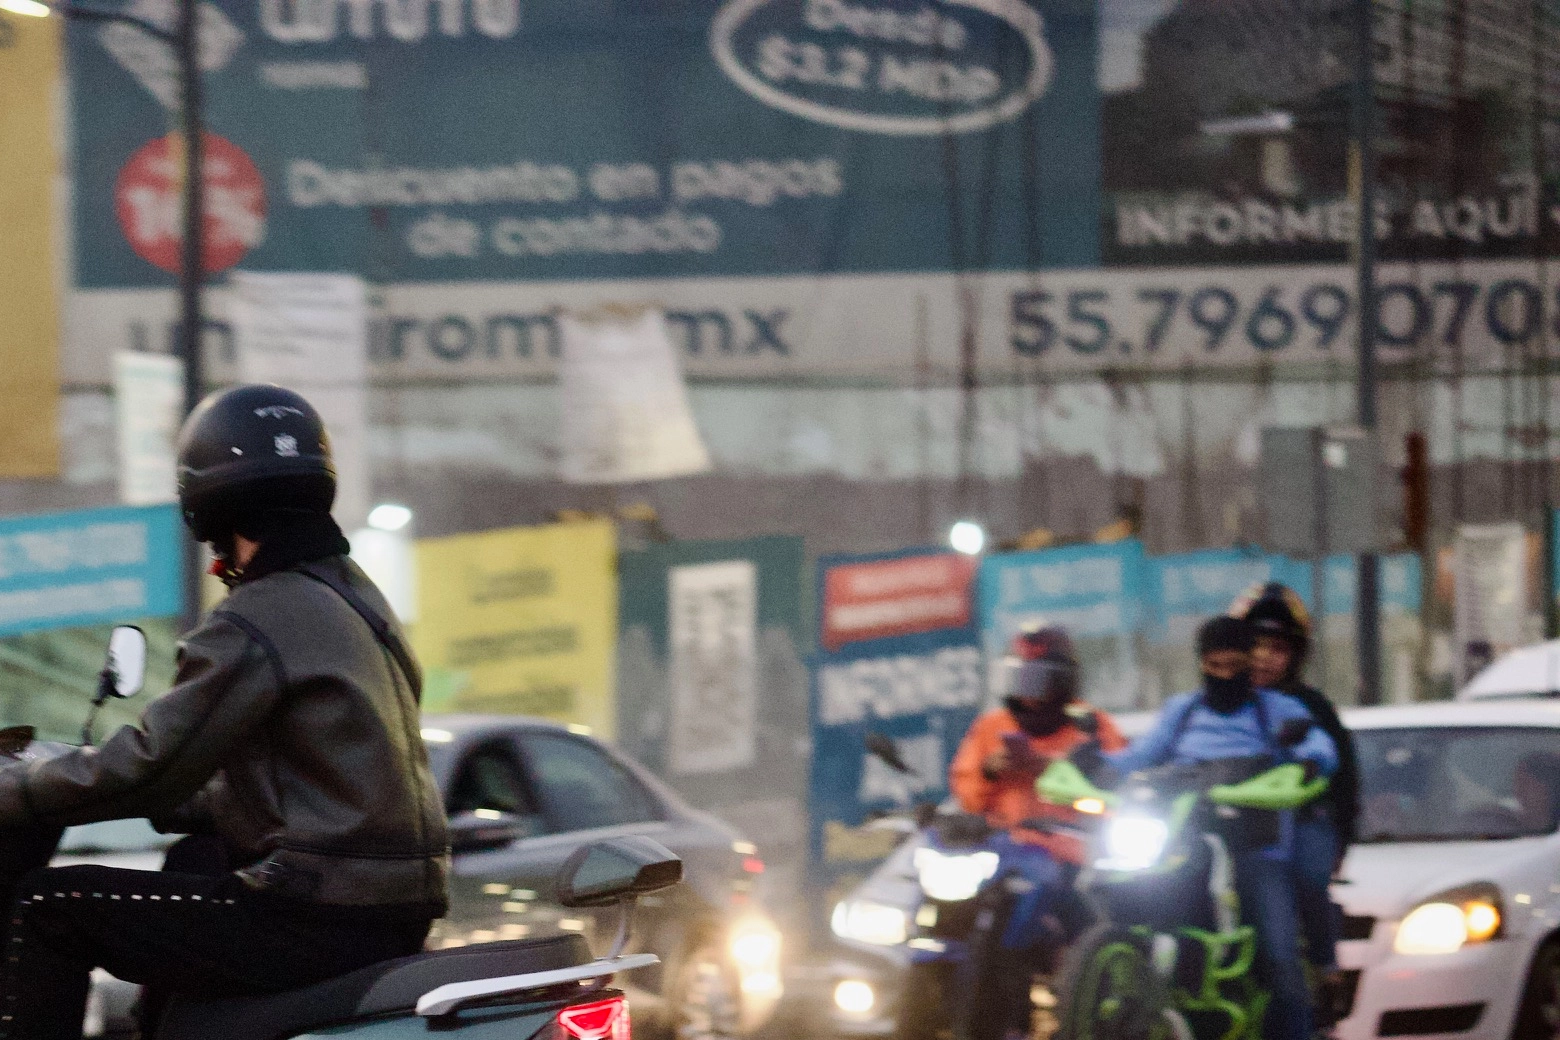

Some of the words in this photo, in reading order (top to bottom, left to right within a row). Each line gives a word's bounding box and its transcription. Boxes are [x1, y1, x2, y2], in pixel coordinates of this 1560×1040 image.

[286, 157, 579, 207] Descuento
[588, 161, 660, 201] en
[672, 157, 843, 207] pagos
[406, 210, 481, 258] de
[490, 210, 723, 257] contado
